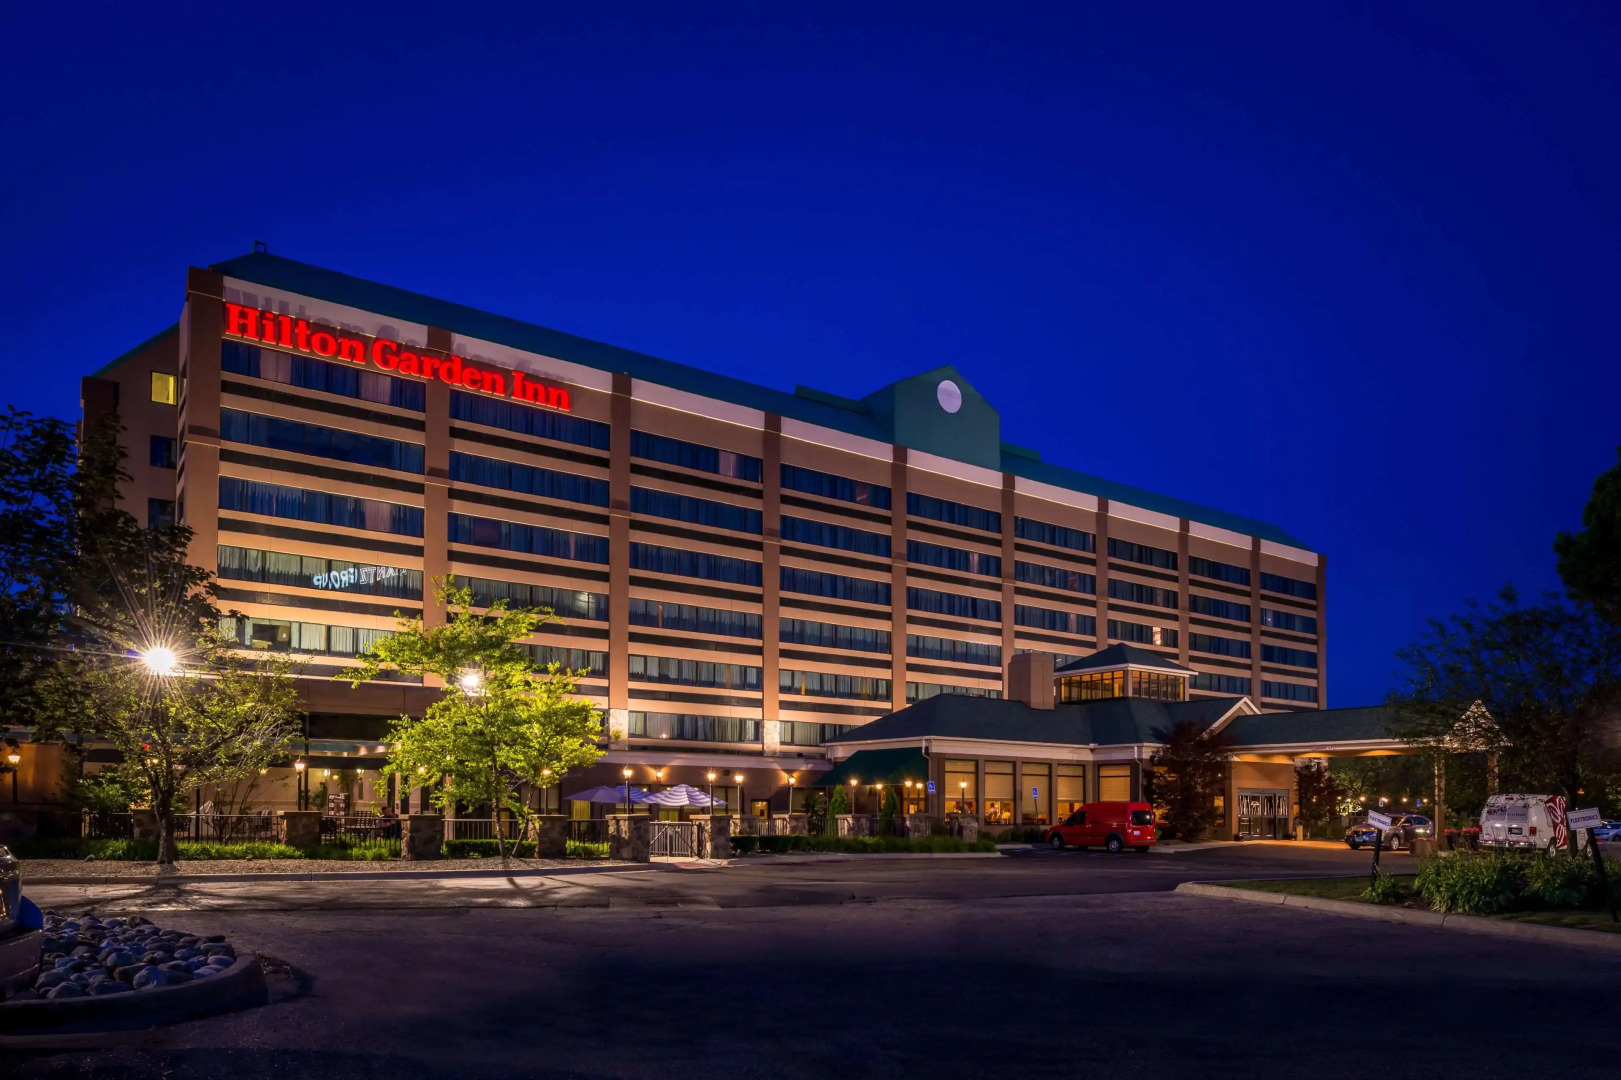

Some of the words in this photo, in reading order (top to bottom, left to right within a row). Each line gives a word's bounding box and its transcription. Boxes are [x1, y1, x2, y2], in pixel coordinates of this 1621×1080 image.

[225, 303, 366, 364] Hilton
[372, 339, 506, 396] Garden
[510, 370, 572, 412] Inn
[1570, 814, 1599, 824] FLEXTRONICS
